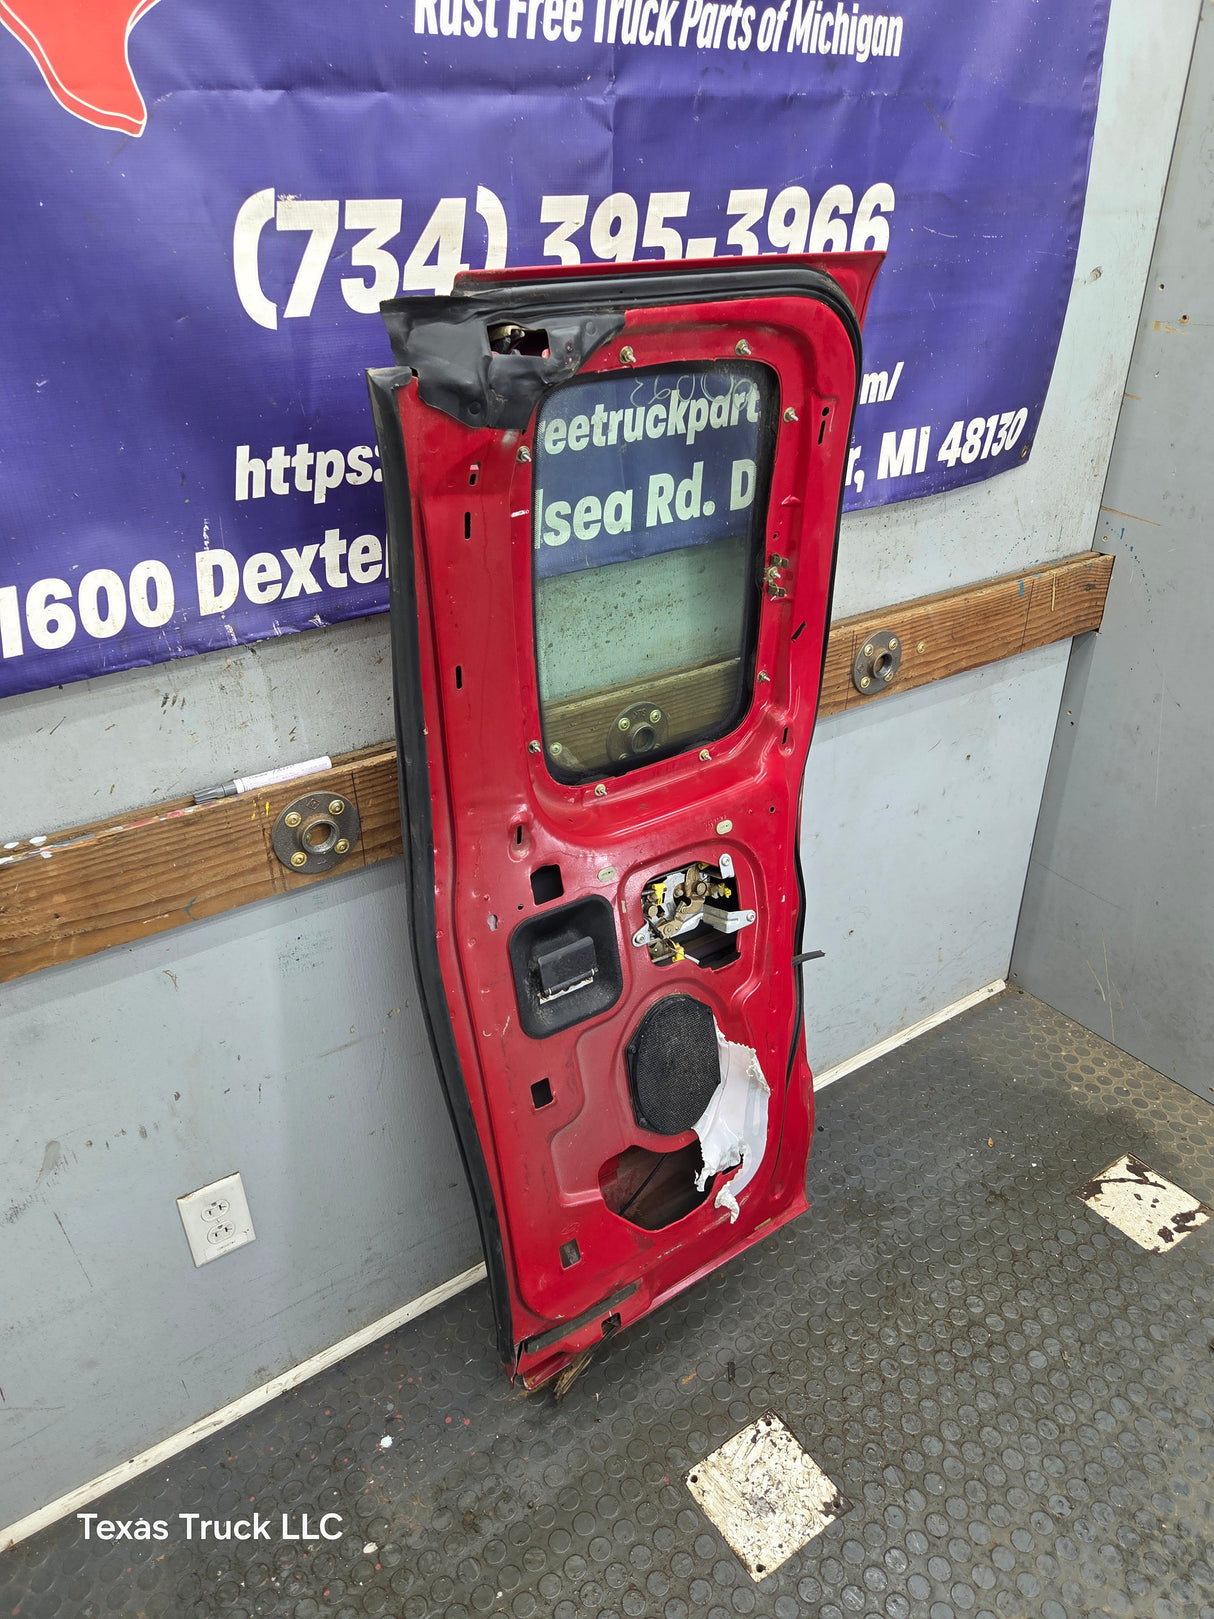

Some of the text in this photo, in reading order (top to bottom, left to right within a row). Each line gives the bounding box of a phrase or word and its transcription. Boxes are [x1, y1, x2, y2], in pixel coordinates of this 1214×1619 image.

[414, 0, 904, 63] Rust Free Truck Parts of Michigan
[233, 182, 896, 331] (734) 395-3966
[536, 382, 761, 456] eetruckpart
[195, 528, 390, 617] Dexte
[645, 461, 716, 528] Rd.
[876, 425, 932, 481] MI
[937, 407, 1029, 468] 48130
